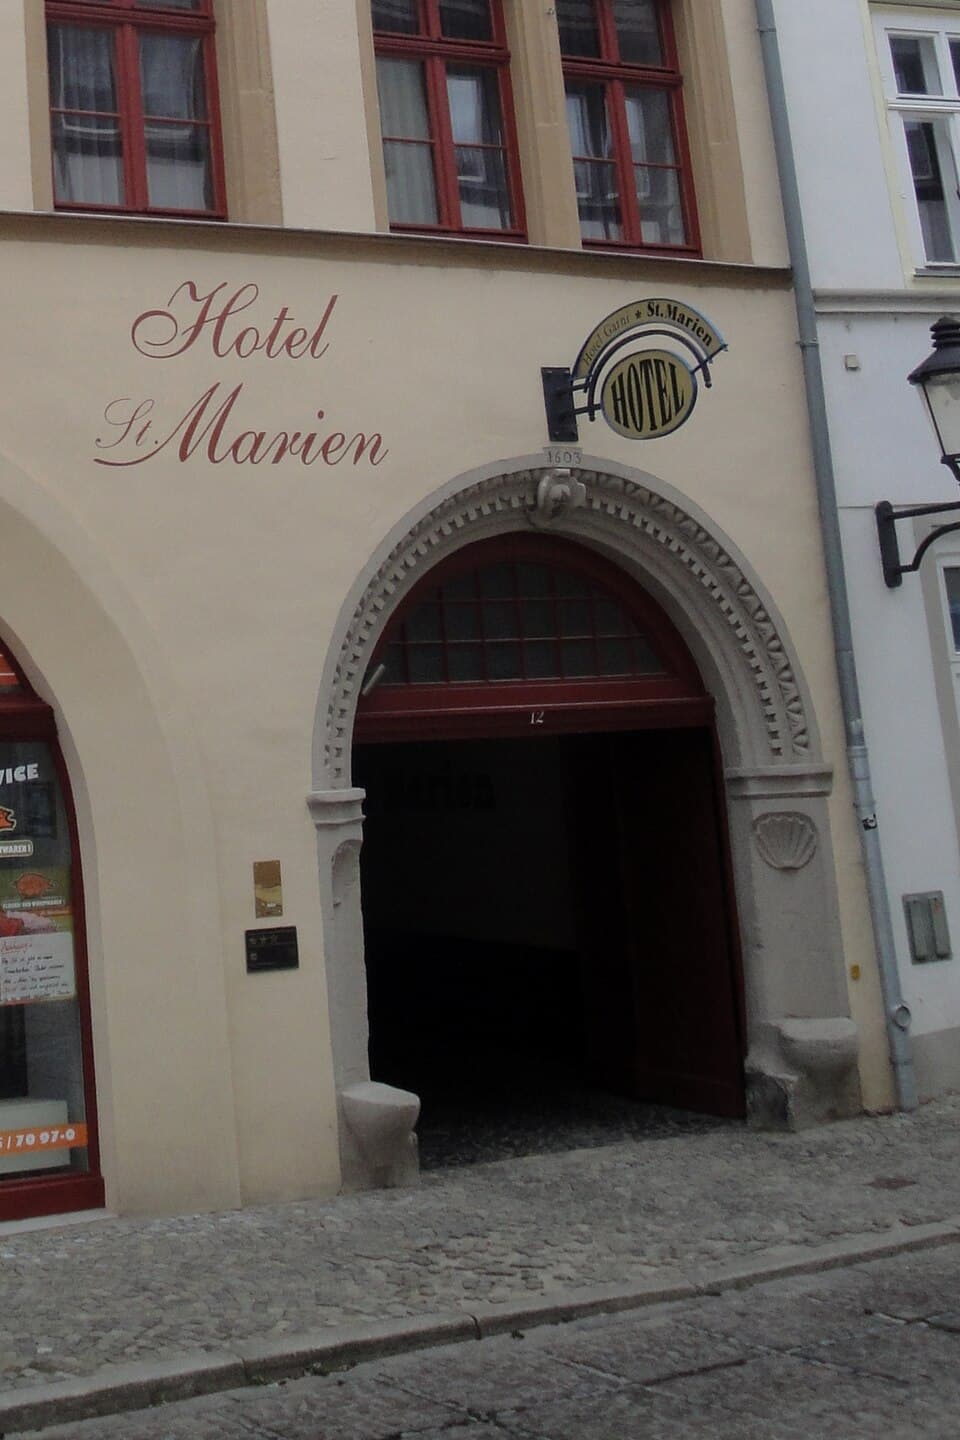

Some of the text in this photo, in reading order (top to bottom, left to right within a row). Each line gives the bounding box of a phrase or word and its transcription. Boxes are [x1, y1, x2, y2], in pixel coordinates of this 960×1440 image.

[131, 281, 338, 359] Hotel
[611, 359, 684, 432] HOTEL
[93, 382, 389, 466] St. Marien
[547, 452, 581, 464] 1603
[531, 711, 544, 724] 12
[16, 1133, 36, 1147] 70
[39, 1129, 76, 1143] 97-0
